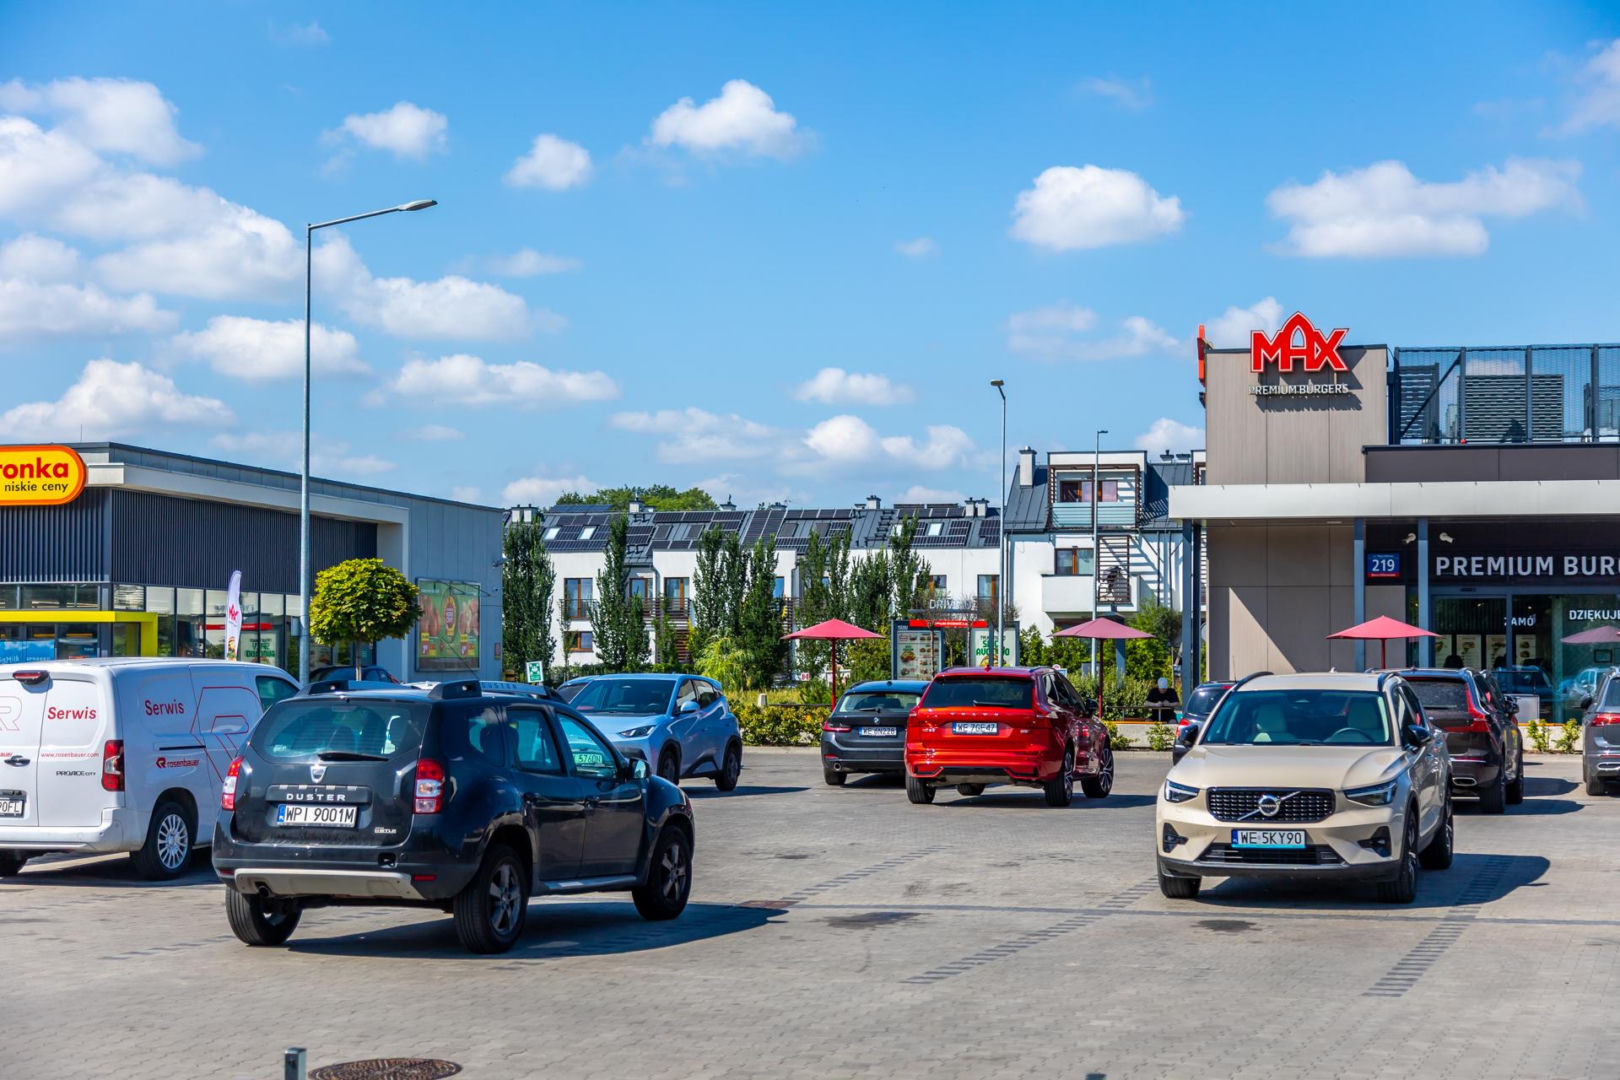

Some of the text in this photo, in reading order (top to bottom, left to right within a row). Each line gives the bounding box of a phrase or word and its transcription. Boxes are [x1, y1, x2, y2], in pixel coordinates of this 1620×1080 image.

[1250, 311, 1350, 373] MAX
[1249, 383, 1349, 395] PREMIUM BURGERS
[4, 481, 69, 493] niskie ceny
[1372, 559, 1395, 572] 219
[1435, 556, 1620, 576] PREMIUM BUR
[47, 706, 97, 720] Serwis
[144, 699, 185, 716] Serwis
[286, 793, 346, 801] DUSTER
[285, 807, 355, 823] WPI 9001M
[1240, 831, 1302, 844] WE 5KY90
